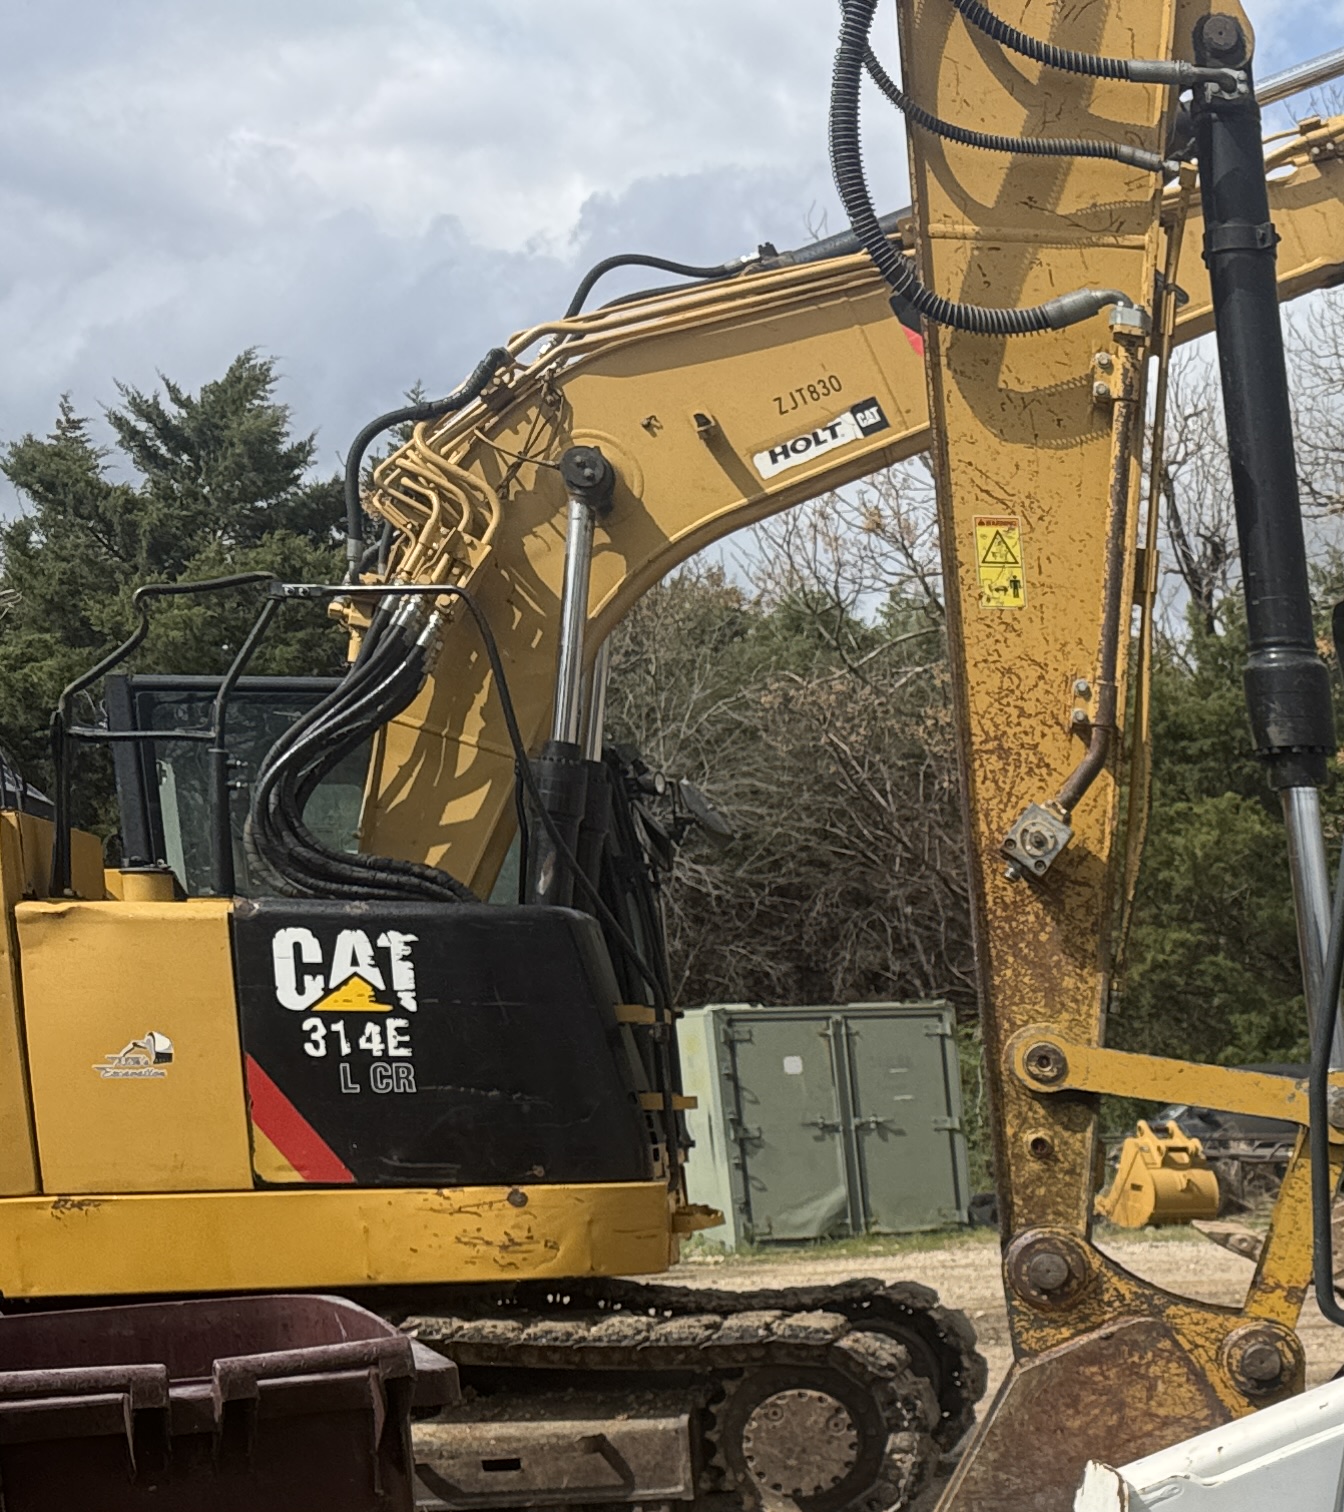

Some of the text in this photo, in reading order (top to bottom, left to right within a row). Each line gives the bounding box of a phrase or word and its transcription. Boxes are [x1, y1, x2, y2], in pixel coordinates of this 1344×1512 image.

[773, 375, 842, 415] ZJT830
[769, 406, 881, 465] HOLT CAT
[272, 927, 419, 1012] CAT
[302, 1017, 412, 1058] 314E
[339, 1062, 417, 1093] L CR
